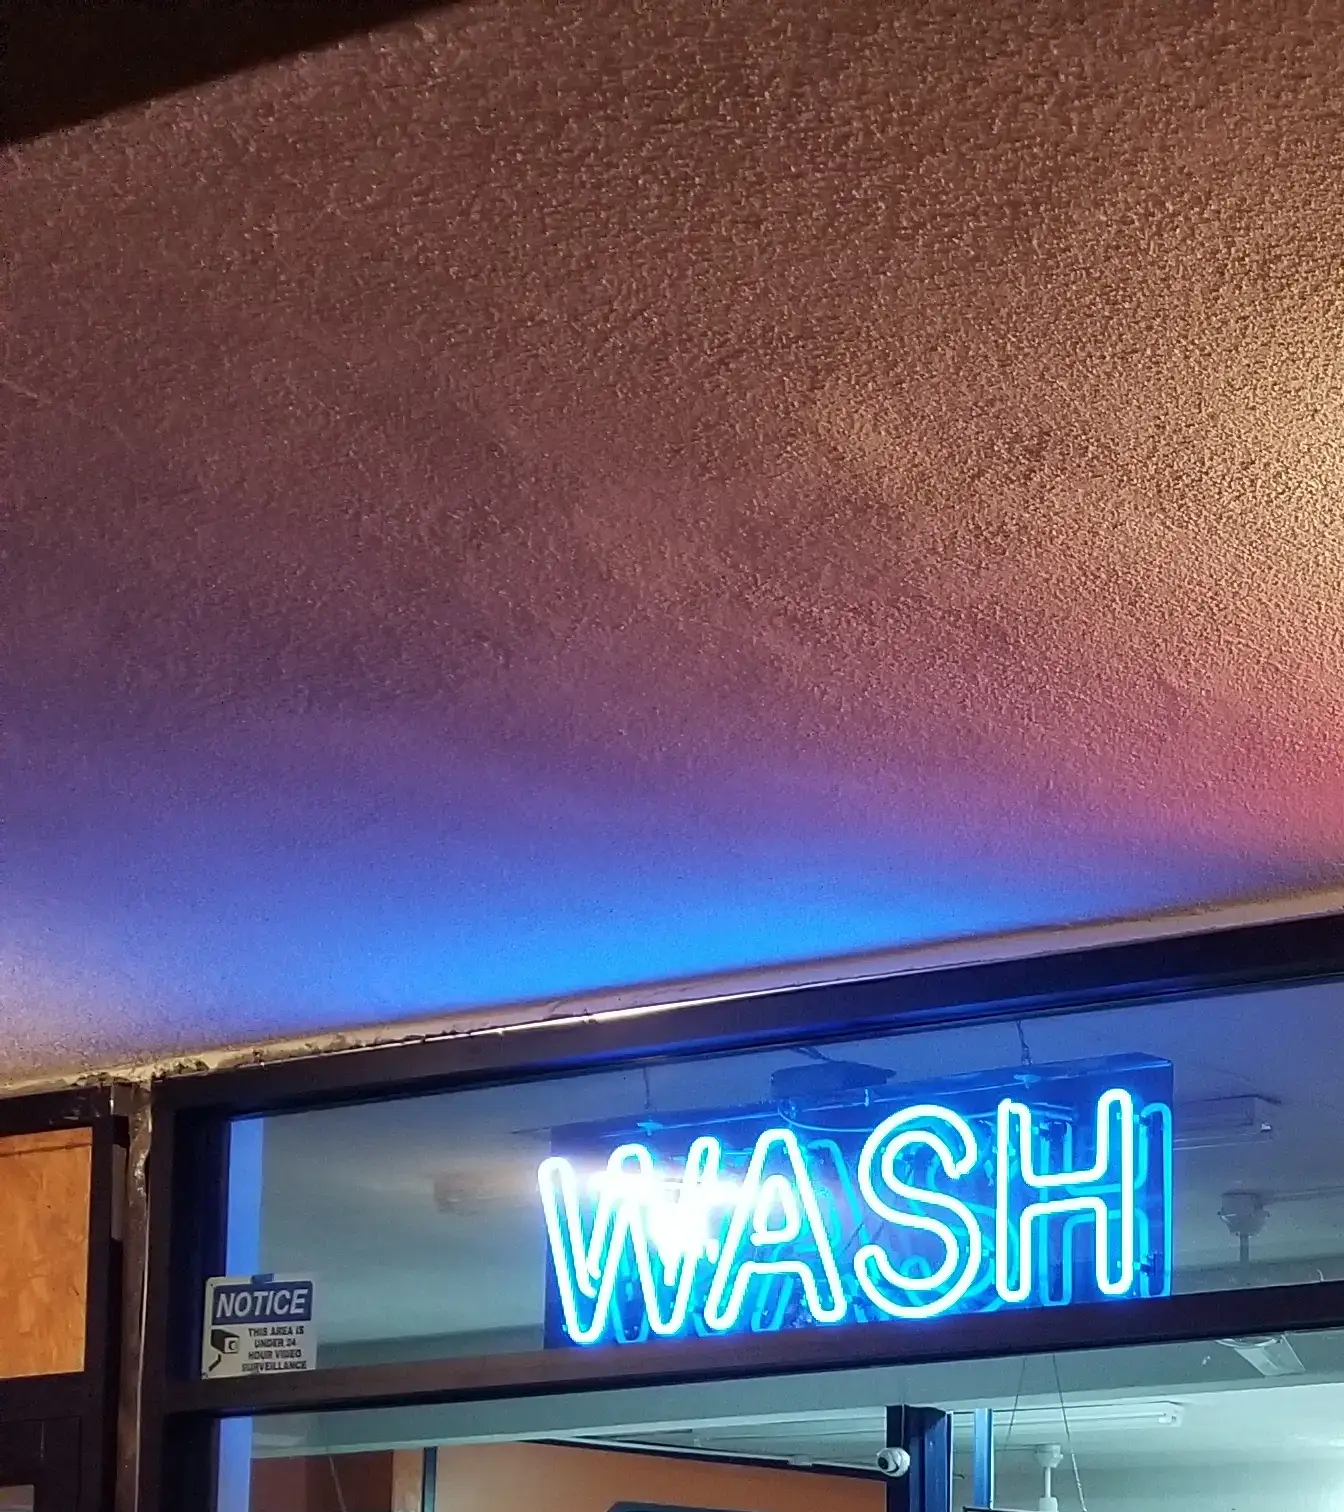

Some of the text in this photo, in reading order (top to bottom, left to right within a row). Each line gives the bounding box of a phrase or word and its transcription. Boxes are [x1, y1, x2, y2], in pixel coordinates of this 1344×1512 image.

[537, 1087, 1134, 1345] WASH
[216, 1288, 308, 1318] NOTICE
[248, 1325, 304, 1337] THIS AREA IS
[255, 1338, 284, 1348] UNDER
[248, 1349, 302, 1360] HOUR VIDEO
[242, 1360, 307, 1372] SURVEILLANCE
